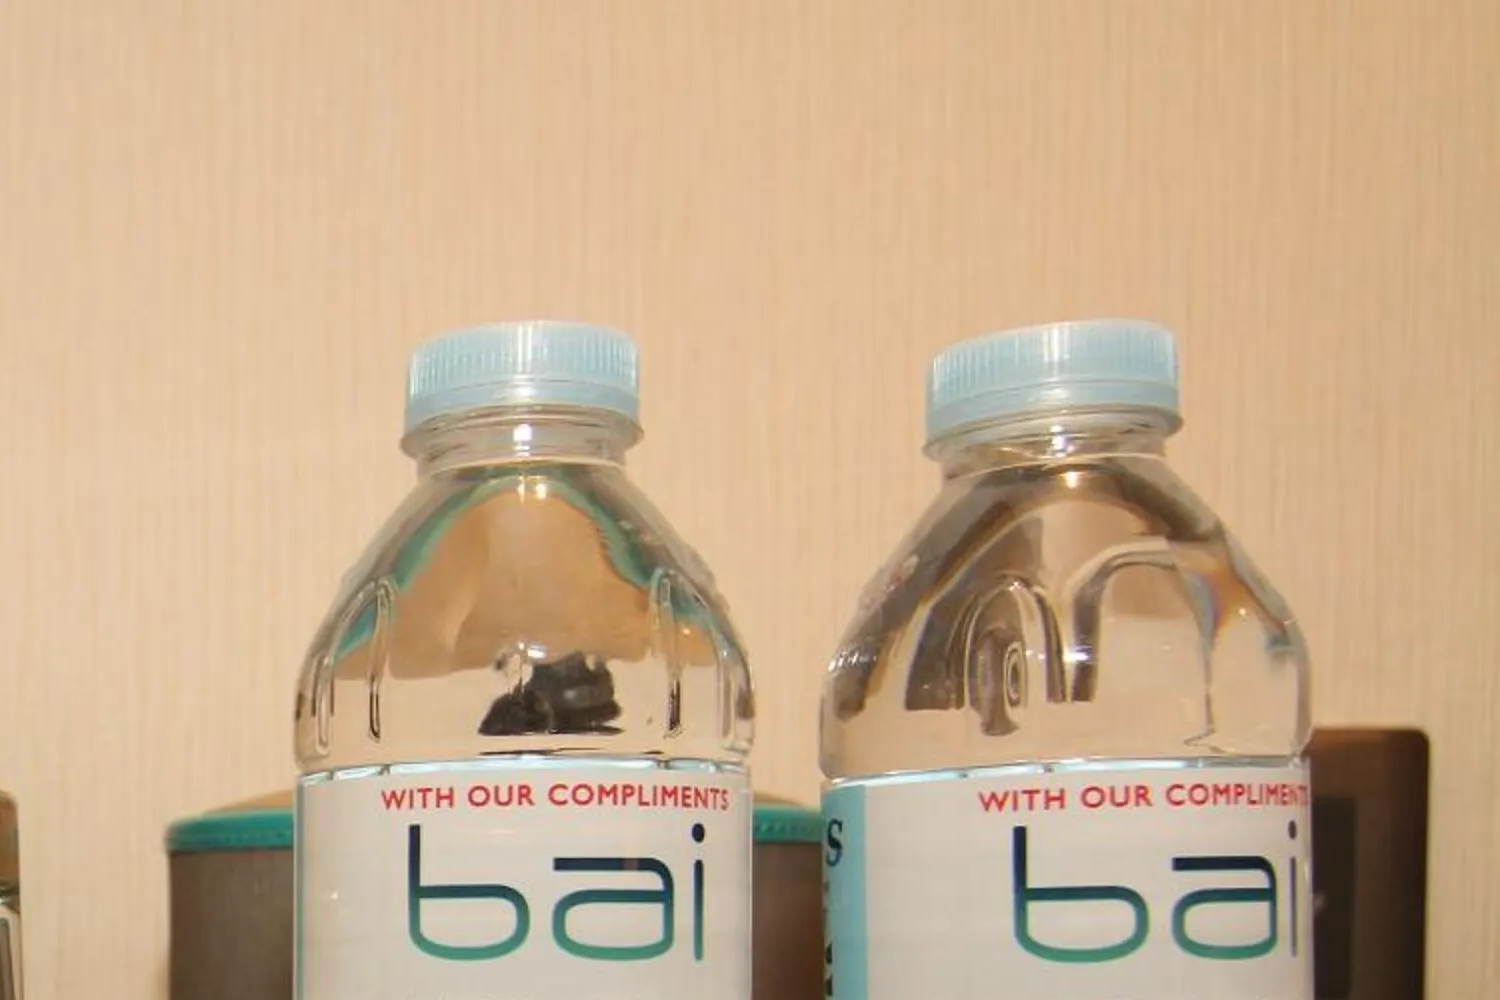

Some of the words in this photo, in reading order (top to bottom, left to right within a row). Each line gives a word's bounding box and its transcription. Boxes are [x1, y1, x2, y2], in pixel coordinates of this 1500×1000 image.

[381, 786, 455, 810] WITH
[467, 783, 535, 808] OUR
[547, 782, 730, 811] COMPLIMENTS
[978, 787, 1067, 812] WITH
[1080, 783, 1153, 808] OUR
[1165, 782, 1309, 808] COMPLIMENT
[408, 822, 706, 962] bai
[1012, 819, 1298, 964] bai
